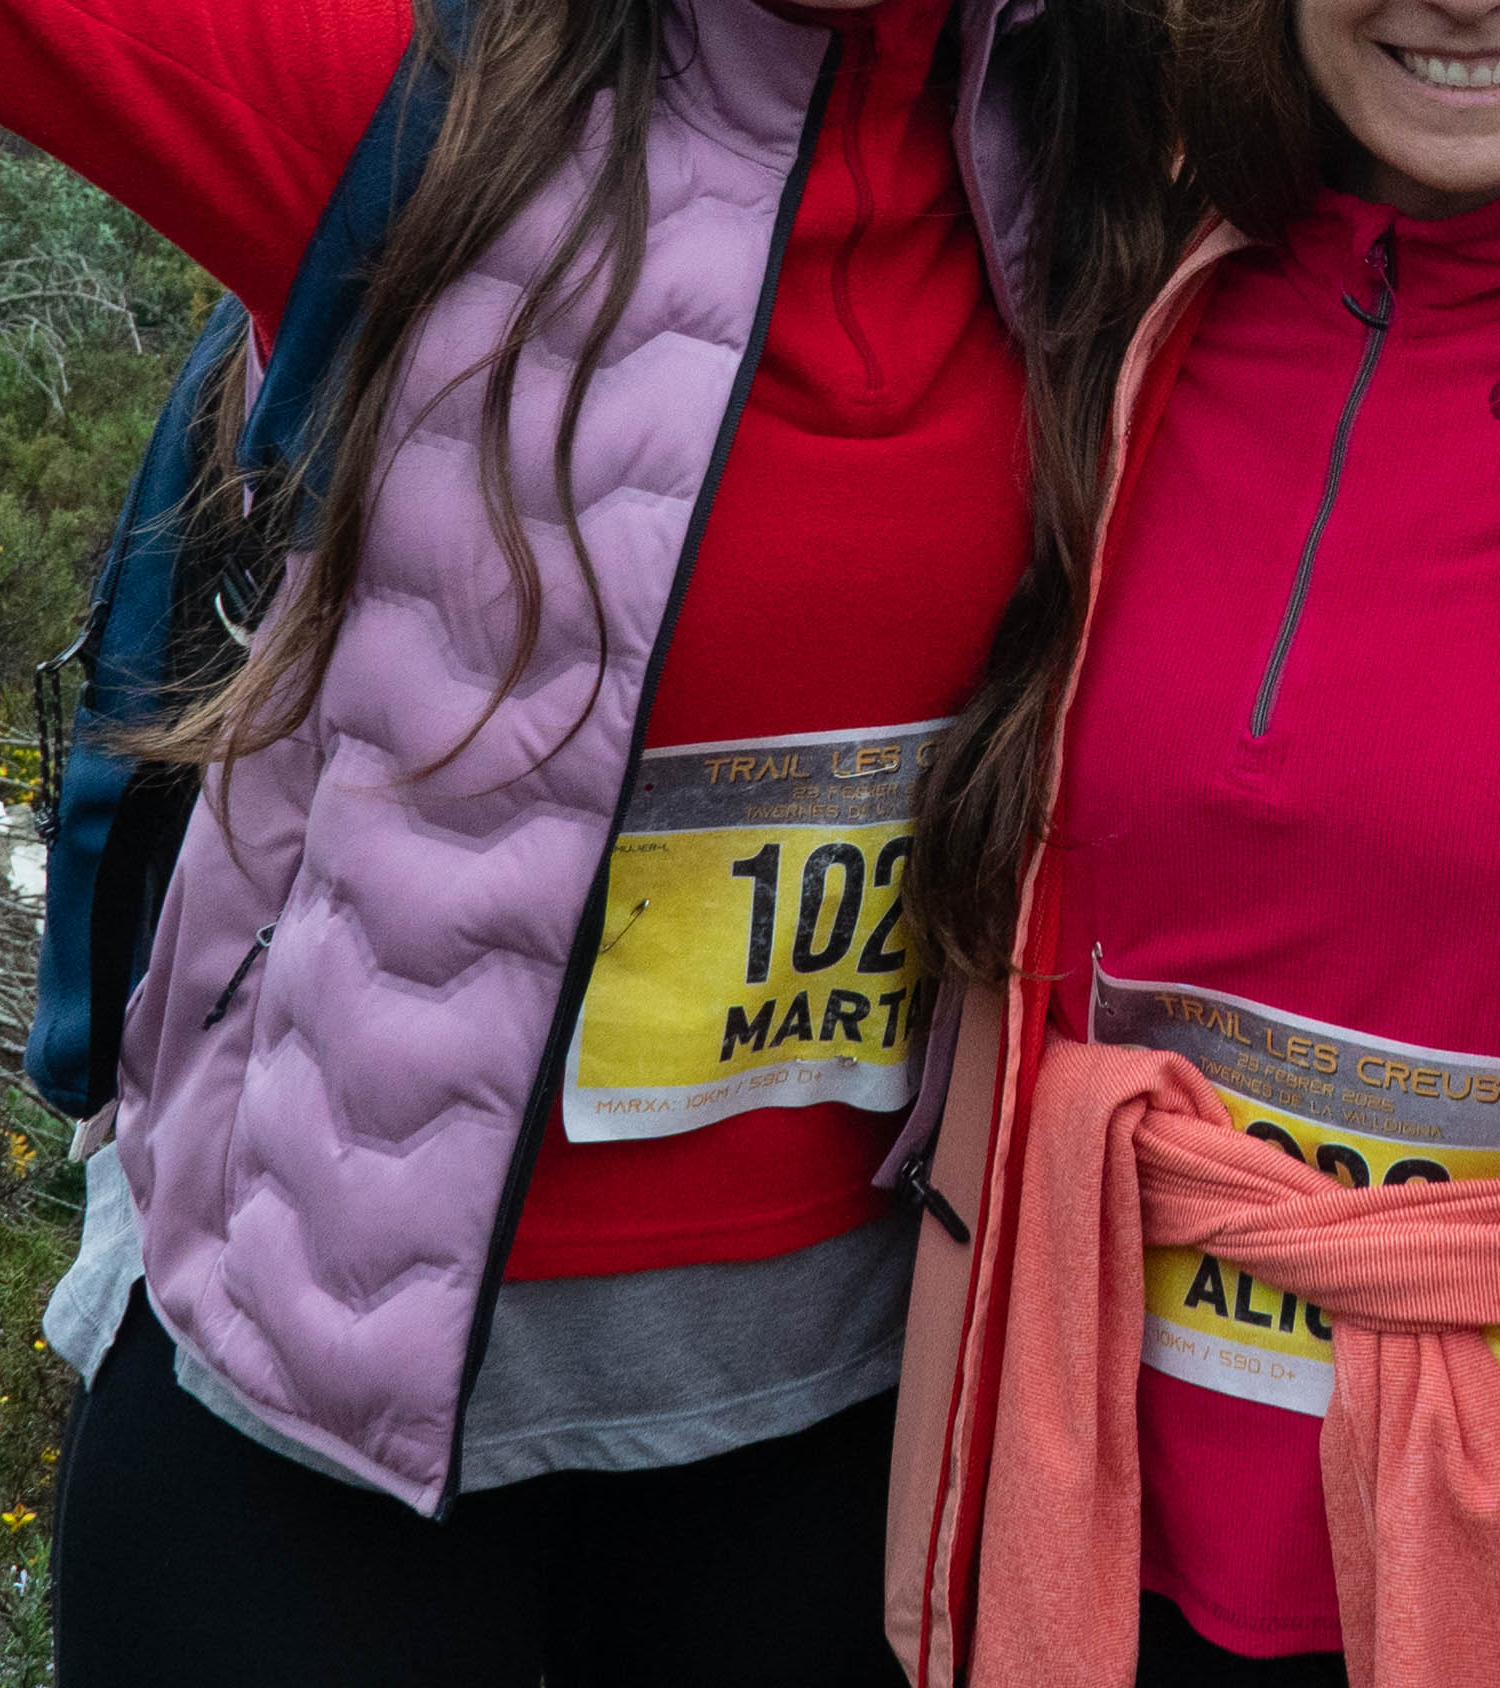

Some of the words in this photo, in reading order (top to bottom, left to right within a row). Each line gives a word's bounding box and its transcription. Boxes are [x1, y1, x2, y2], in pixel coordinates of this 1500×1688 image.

[705, 752, 812, 785] TRAIL
[830, 745, 900, 780] LES
[1155, 994, 1252, 1046] TRAIL
[1265, 1027, 1340, 1075] LES
[749, 1068, 790, 1090] 590
[1200, 1055, 1275, 1099] TAVERNES
[1279, 1089, 1302, 1108] DE
[1310, 1100, 1334, 1117] LA
[1219, 1349, 1262, 1375] 590
[1269, 1363, 1297, 1380] D+
